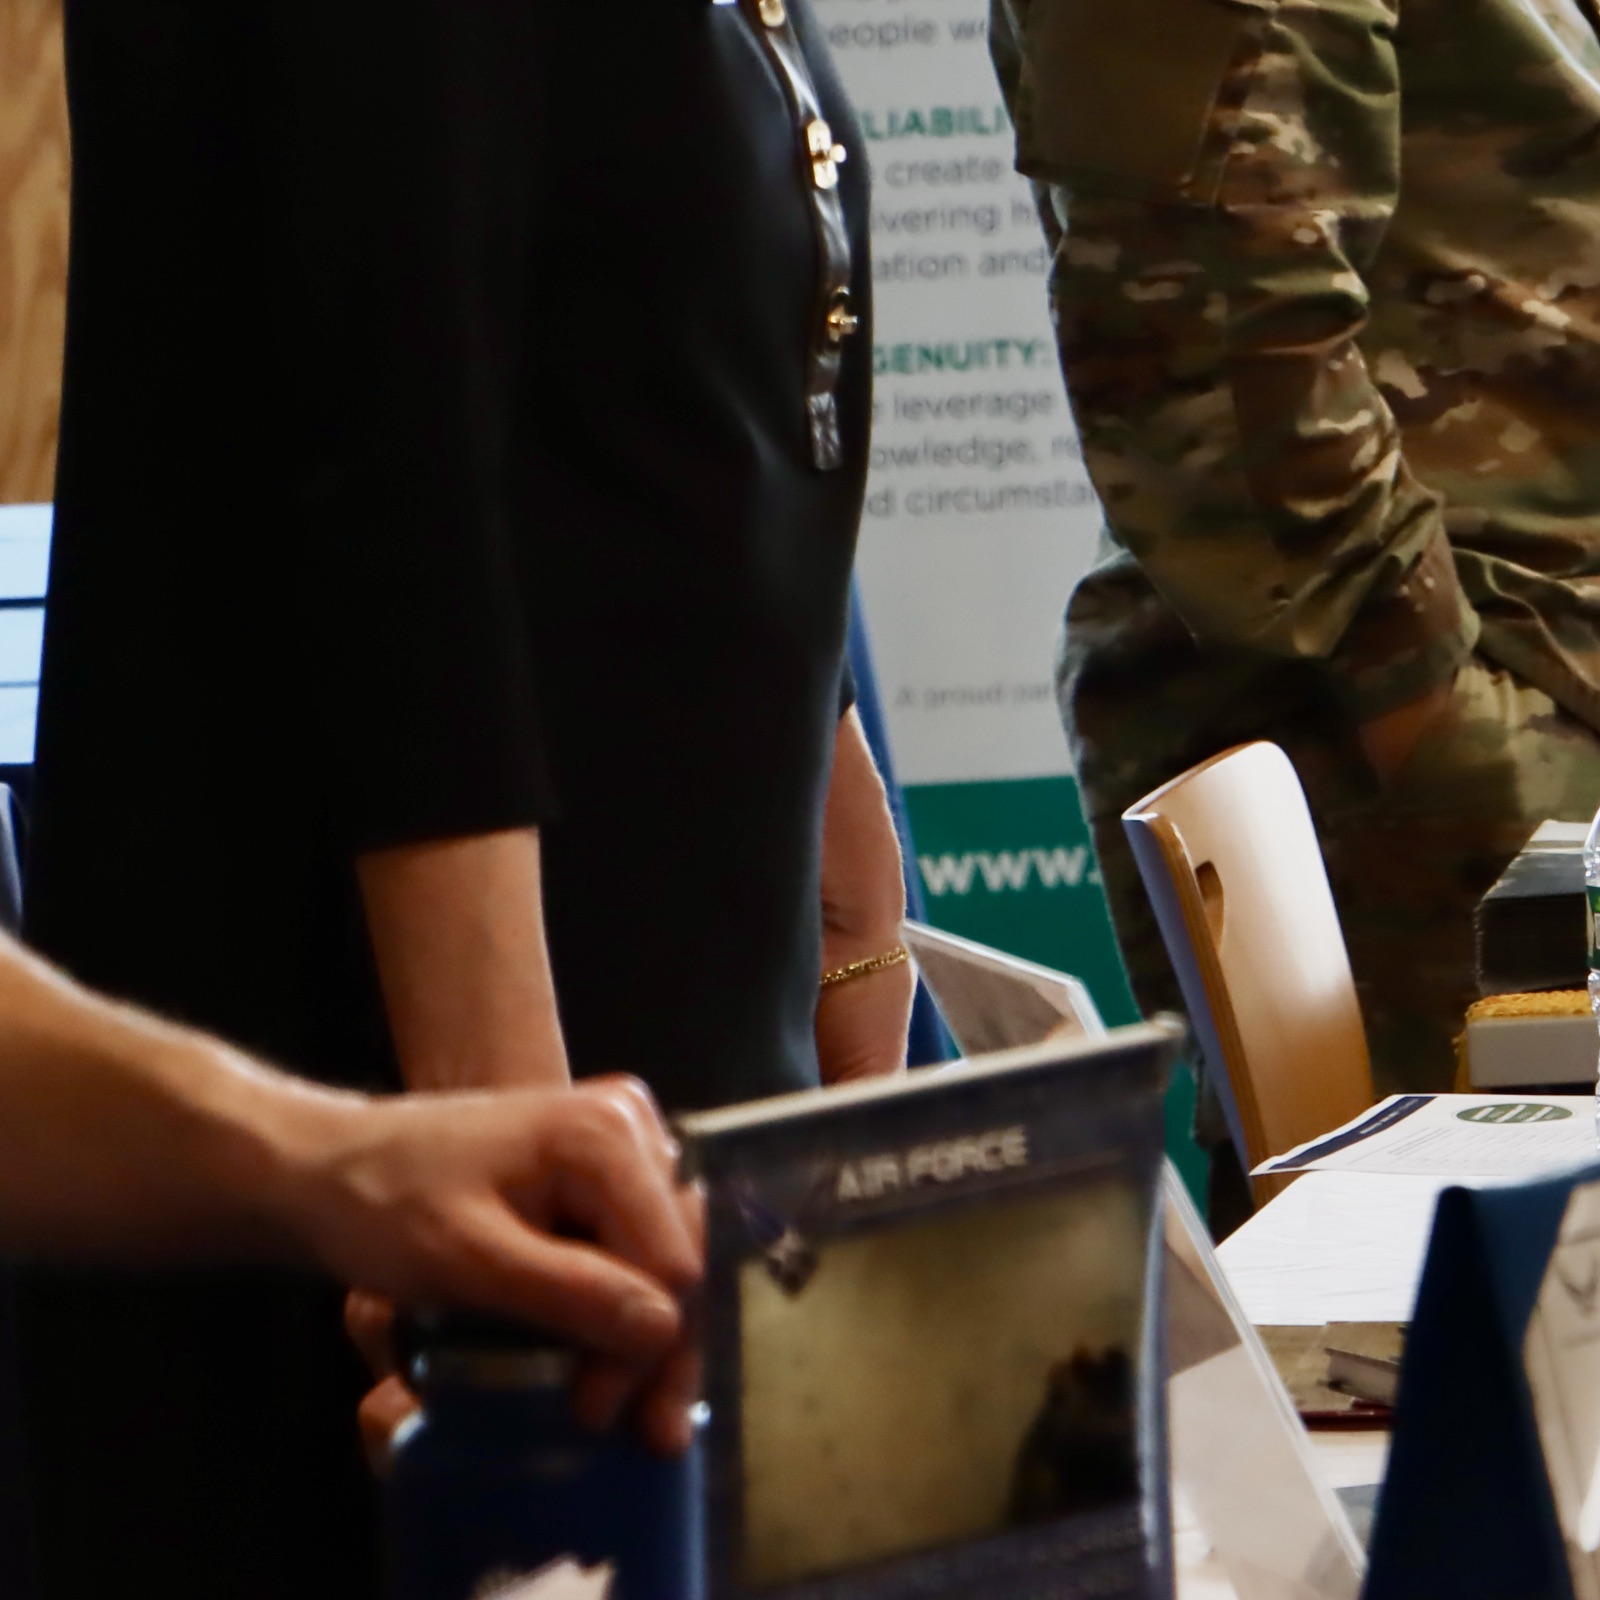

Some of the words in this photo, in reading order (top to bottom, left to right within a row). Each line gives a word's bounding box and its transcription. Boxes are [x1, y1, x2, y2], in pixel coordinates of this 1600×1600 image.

[827, 13, 937, 50] eople
[884, 153, 1005, 188] create
[893, 391, 1053, 424] leverage
[838, 1151, 899, 1203] AIR
[906, 1123, 1028, 1185] FORCE
